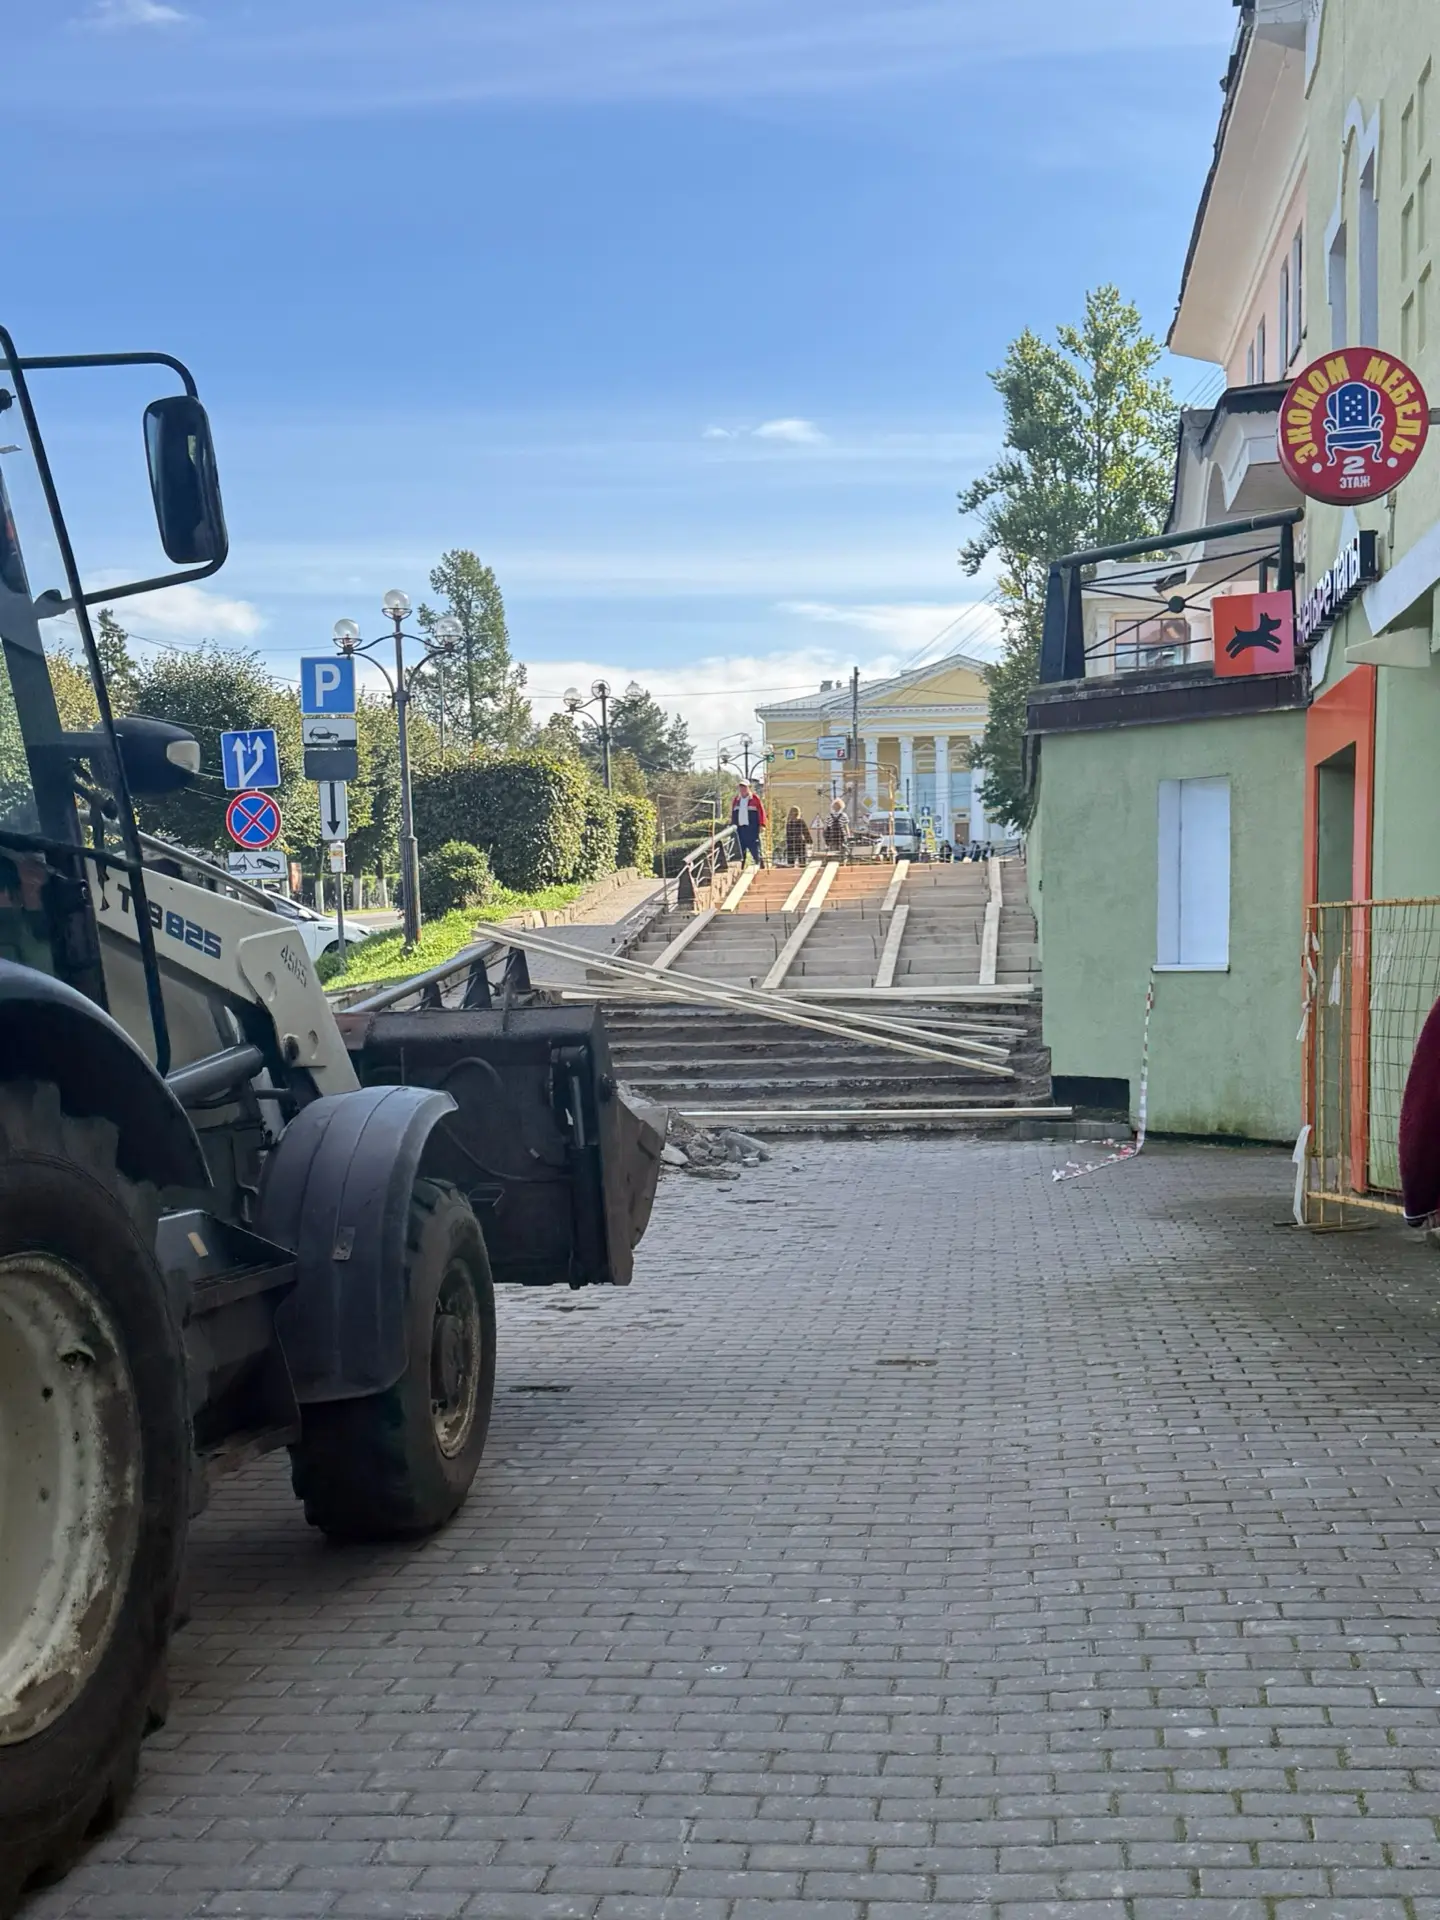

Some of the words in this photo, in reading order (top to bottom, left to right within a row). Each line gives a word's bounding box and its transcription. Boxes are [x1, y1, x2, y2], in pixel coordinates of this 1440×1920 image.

[1286, 355, 1351, 464] ЭКОНОМ
[1362, 355, 1422, 454] МЕБЕЛЬ
[1339, 475, 1371, 489] ЭТАЖ
[1342, 455, 1366, 475] 2
[1331, 528, 1361, 607] лапы
[314, 663, 341, 708] P
